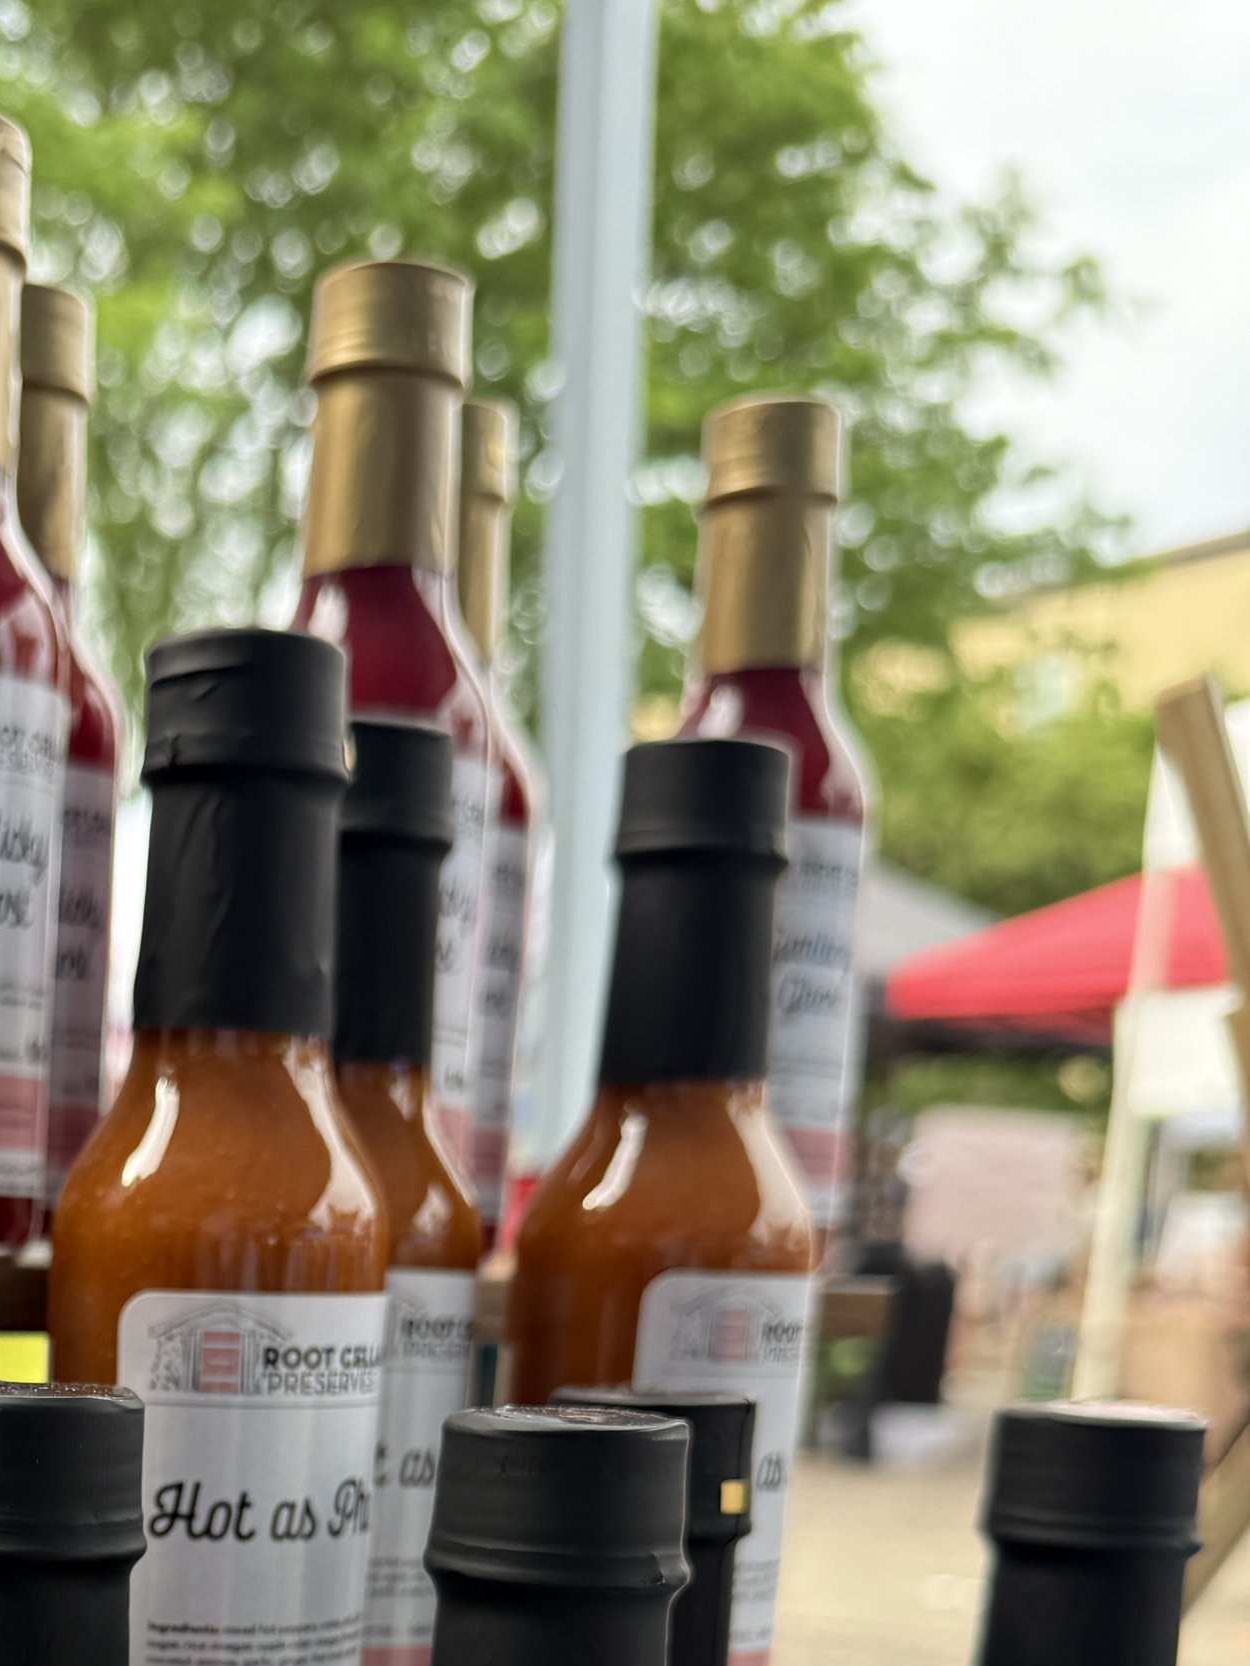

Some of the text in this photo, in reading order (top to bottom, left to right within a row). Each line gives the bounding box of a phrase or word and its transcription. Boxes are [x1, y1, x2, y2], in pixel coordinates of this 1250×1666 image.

[262, 1346, 334, 1372] ROOT
[149, 1480, 256, 1543] Hot
[269, 1495, 318, 1542] as
